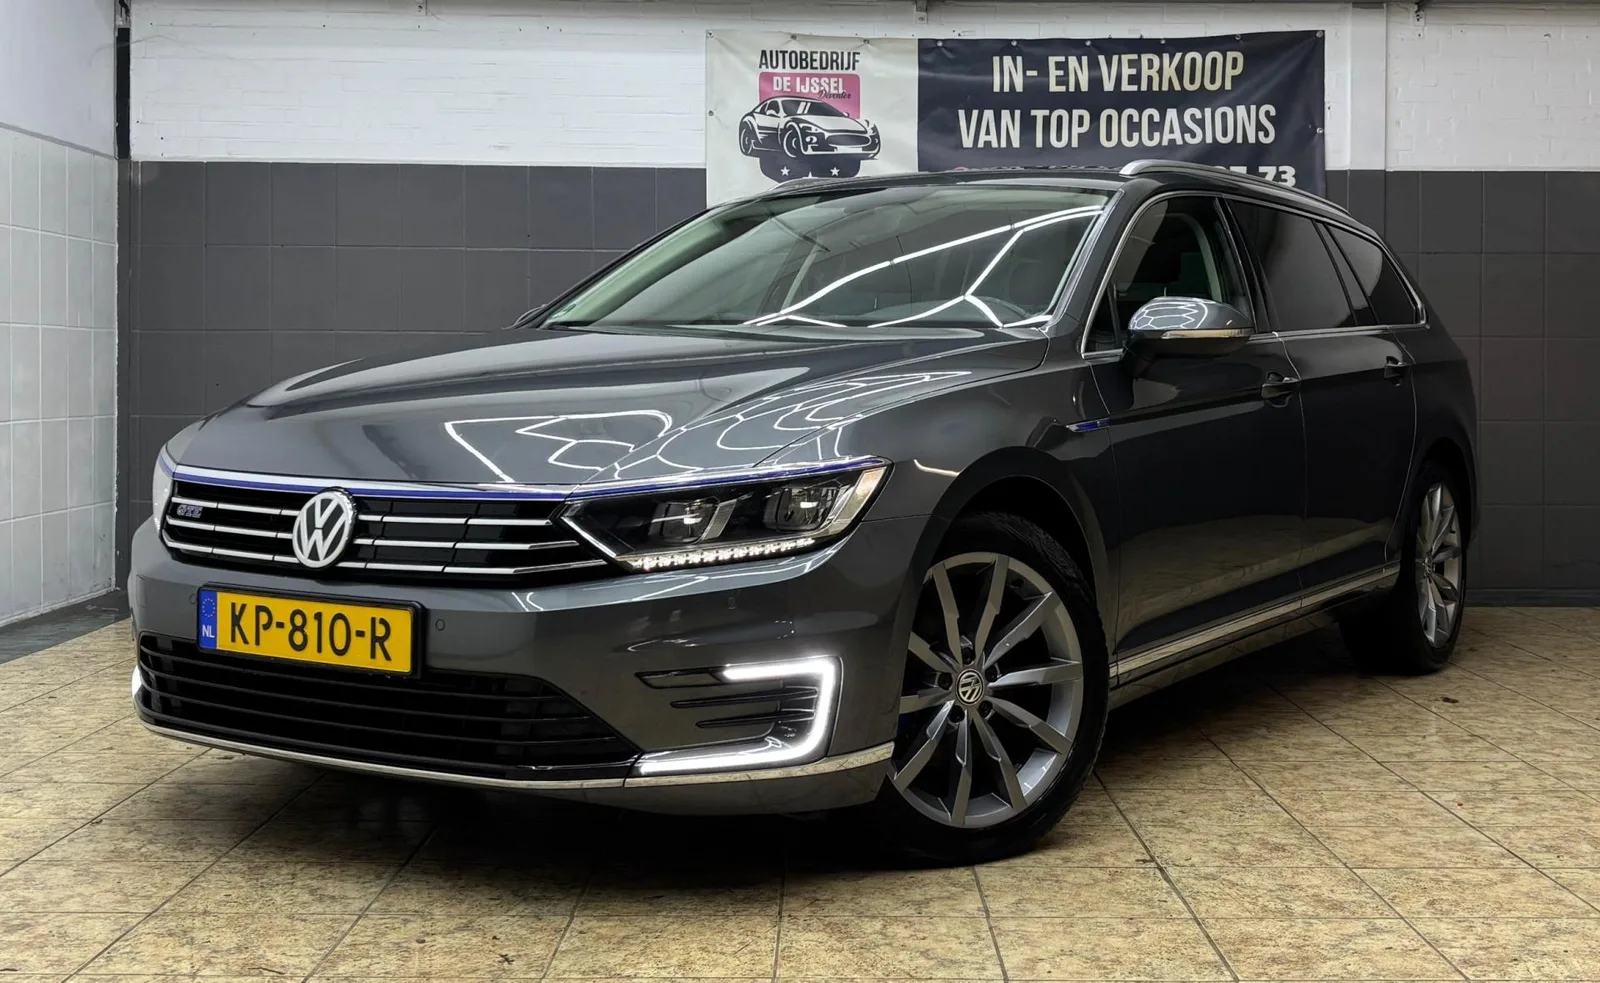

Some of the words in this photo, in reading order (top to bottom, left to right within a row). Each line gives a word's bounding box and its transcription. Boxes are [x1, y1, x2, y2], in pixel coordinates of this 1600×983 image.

[759, 49, 860, 70] AUTOBEDRIJF
[992, 55, 1038, 92] IN-
[1048, 55, 1089, 92] EN
[1098, 51, 1244, 92] VERKOOP
[773, 76, 791, 91] DE
[796, 77, 845, 94] IJSSEL
[958, 109, 1021, 149] VAN
[1030, 109, 1090, 148] TOP
[1099, 104, 1276, 147] OCCASIONS
[202, 625, 215, 639] NL
[230, 602, 392, 662] KP-810-R
